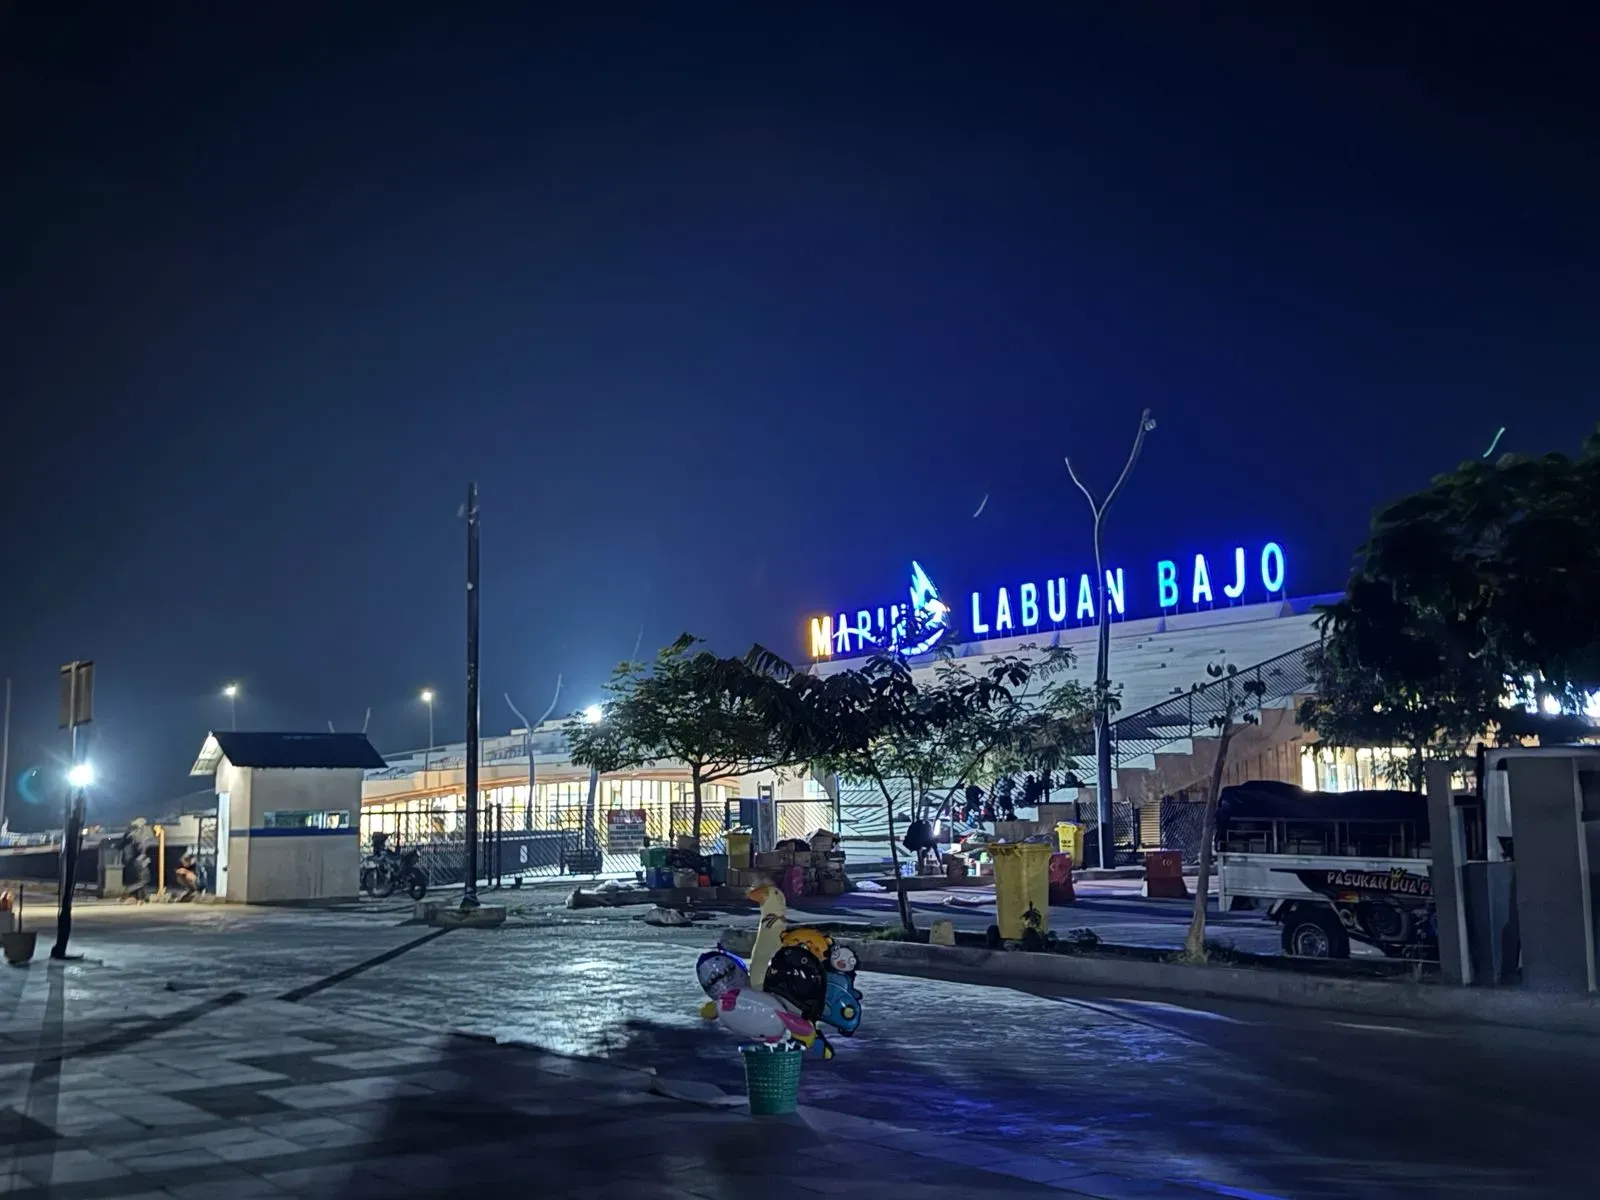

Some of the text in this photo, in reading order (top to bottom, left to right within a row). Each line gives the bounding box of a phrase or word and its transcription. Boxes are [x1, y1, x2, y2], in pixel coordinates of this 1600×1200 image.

[972, 567, 1126, 634] LABUAN
[1157, 541, 1287, 608] BAJO
[1327, 872, 1388, 890] PASUKAN
